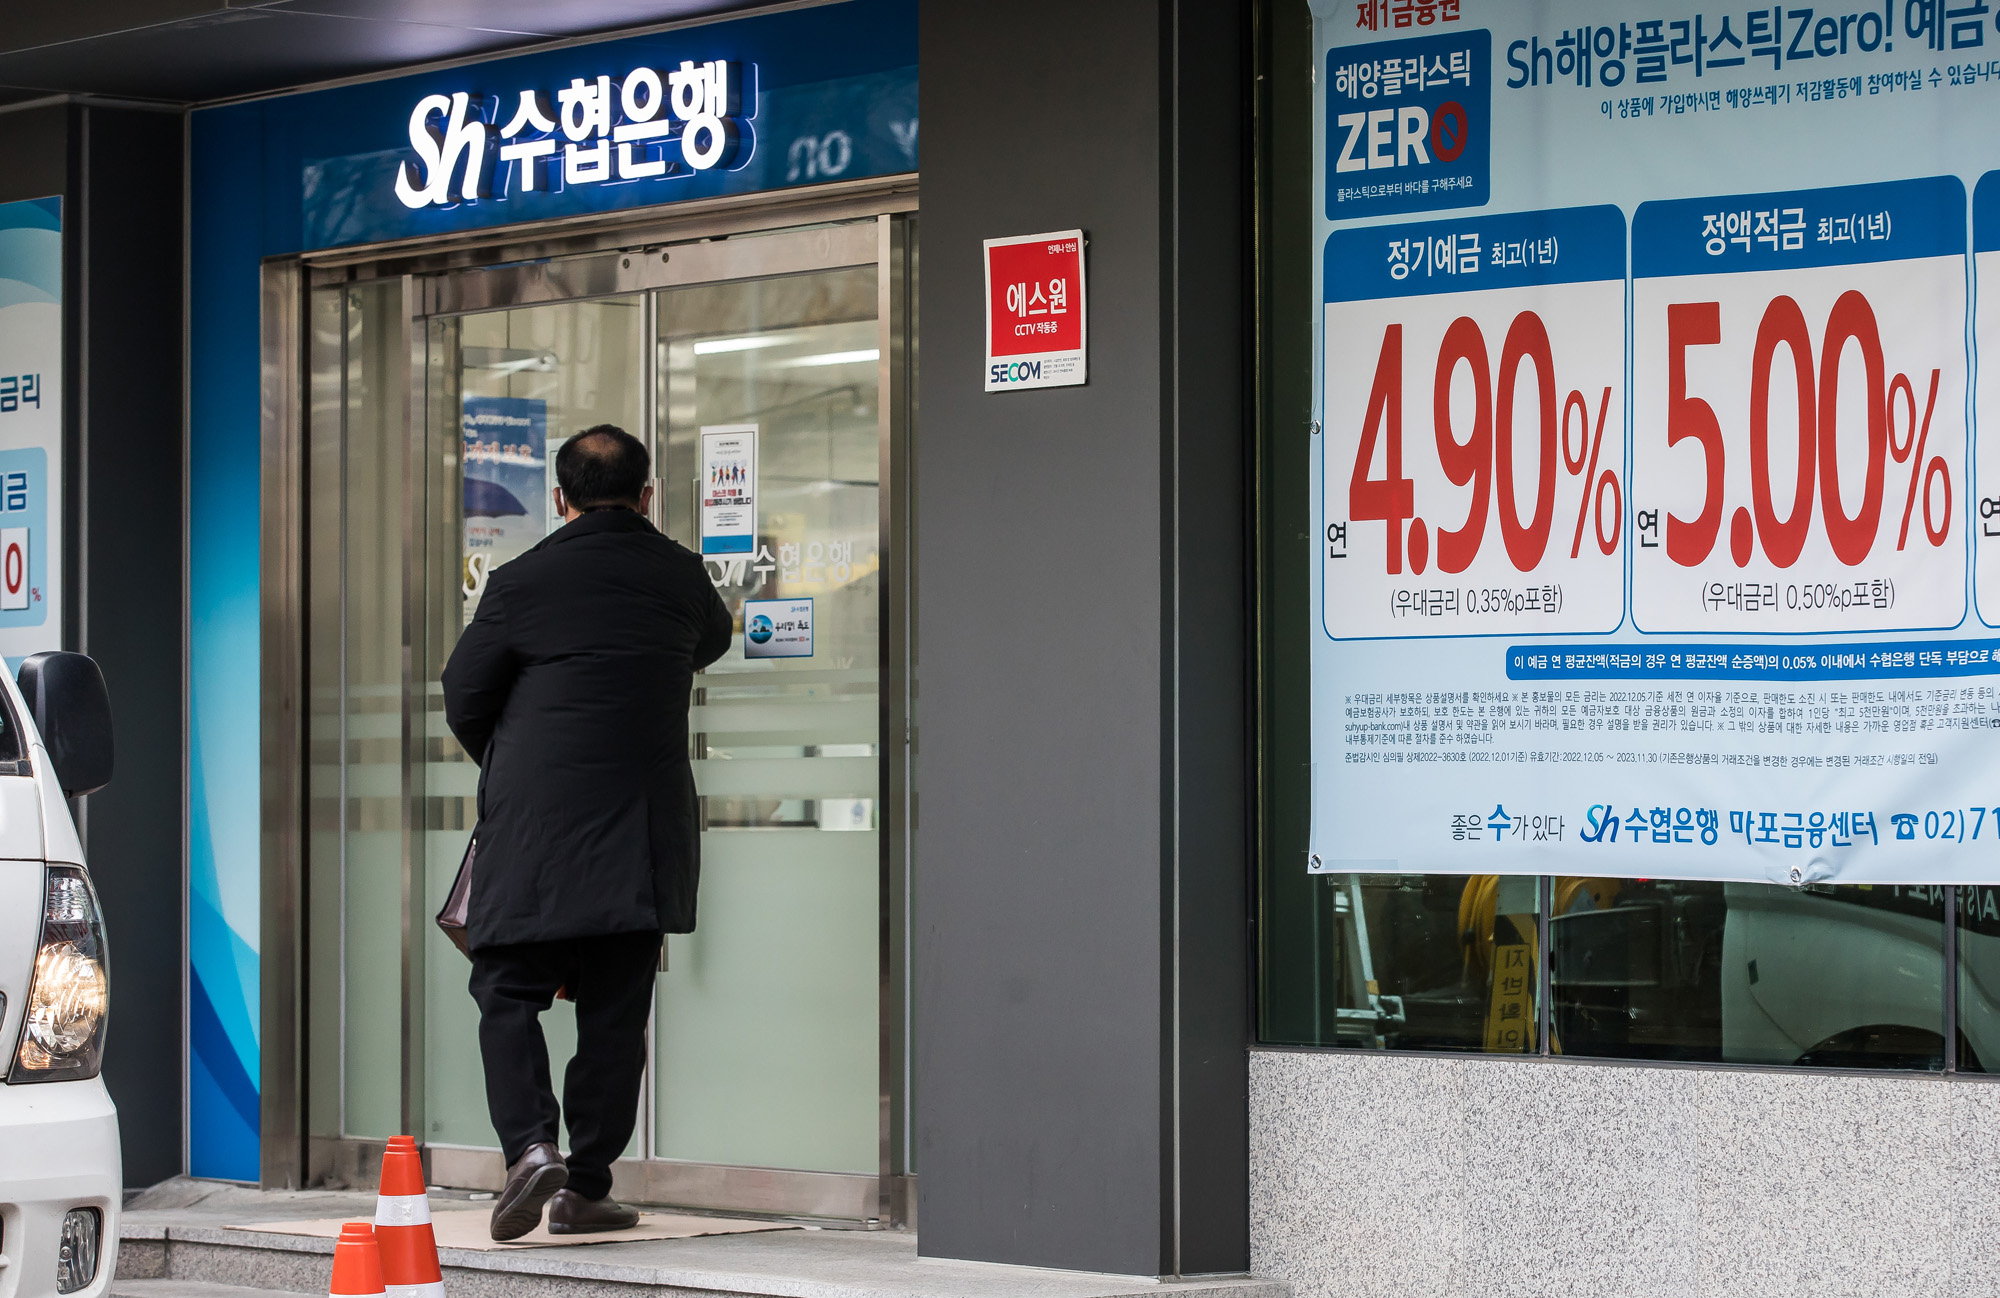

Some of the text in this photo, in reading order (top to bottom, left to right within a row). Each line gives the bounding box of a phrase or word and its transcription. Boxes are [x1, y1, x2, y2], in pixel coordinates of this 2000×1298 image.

[1506, 0, 2000, 89] Sh해양플라스틱Zero! 예금
[1336, 50, 1470, 99] 해양플라스틱
[1601, 100, 1612, 119] 이
[1618, 97, 1653, 119] 상품에
[1660, 91, 1720, 114] 가입하시면
[1726, 83, 1790, 109] 해양쓰레기
[1796, 76, 1862, 102] 저감활동에
[1868, 69, 1921, 95] 참여하실
[1928, 67, 1942, 88] 수
[395, 92, 486, 210] Sh
[500, 60, 728, 193] 수협은행
[1336, 101, 1468, 173] ZERO
[1337, 176, 1473, 201] 플라스틱으로부터 바다를 구해주세요
[1065, 242, 1076, 252] 안심
[1702, 208, 1891, 256] 정액적금 최고(1년)
[1388, 233, 1558, 280] 정기예금 최고(1년)
[1007, 278, 1067, 318] 에스원
[1015, 321, 1057, 336] CCTV 작동중
[991, 361, 1040, 383] SECOM
[1327, 310, 1621, 576] 연 4.90%
[1638, 290, 1952, 568] 연 5.00%
[753, 541, 852, 584] 수협은행
[1390, 584, 1563, 618] (우대금리 0.35%p포함)
[1702, 578, 1895, 611] (우대금리 0.50%p포함)
[1514, 650, 1988, 670] 이 예금 연 평균잔액(적금의 경우 연 평균잔액 순증액)의 0.05% 이내에서 수협은행 단독 부담으로
[1346, 707, 1396, 718] 예금보험공사가
[1400, 706, 1430, 717] 보호하되,
[1434, 706, 1448, 716] 보호
[1452, 706, 1474, 717] 한도는
[1478, 706, 1485, 716] 본
[1489, 706, 1511, 717] 은행에
[1515, 705, 1530, 716] 있는
[1534, 705, 1557, 716] 귀하의
[1561, 705, 1576, 716] 모든
[1582, 705, 1620, 716] 예금자보호
[1625, 705, 1640, 716] 대상
[1645, 705, 1686, 718] 금융상품의
[1691, 706, 1716, 718] 원금과
[1721, 706, 1744, 718] 소정의
[1750, 707, 1774, 719] 이자를
[1779, 707, 1803, 719] 합하여
[1809, 707, 1829, 719] 1인당
[1953, 702, 1986, 714] 초과하는
[1354, 694, 1382, 704] 우대금리
[1386, 693, 1422, 704] 세부항목은
[1426, 692, 1468, 704] 상품설명서를
[1472, 692, 1509, 702] 확인하세요
[1521, 692, 1528, 702] 본
[1532, 692, 1561, 702] 홍보물의
[1565, 691, 1580, 702] 모든
[1584, 691, 1606, 702] 금리는
[1667, 691, 1682, 702] 세전
[1687, 691, 1694, 703] 연
[1698, 692, 1722, 703] 이자율
[1726, 692, 1759, 704] 기준으로,
[1763, 693, 1795, 704] 판매한도
[1799, 693, 1815, 704] 소진
[1819, 693, 1827, 703] 시
[1831, 693, 1847, 703] 또는
[1852, 692, 1884, 703] 판매한도
[1889, 691, 1922, 703] 내에서도
[1926, 689, 1957, 701] 기준금리
[1978, 687, 1994, 700] 등의
[1346, 733, 1494, 745] 내부통제기준에 따른 절차를 준수 하였습니다.
[1413, 720, 1427, 731] 상품
[1432, 720, 1453, 731] 설명서
[1457, 720, 1463, 731] 및
[1466, 719, 1488, 731] 약관을
[1492, 719, 1506, 731] 읽어
[1509, 719, 1531, 730] 보시기
[1535, 719, 1559, 730] 바라며,
[1563, 719, 1585, 731] 필요한
[1589, 719, 1603, 730] 경우
[1607, 719, 1629, 731] 설명을
[1633, 719, 1648, 731] 받을
[1652, 719, 1677, 731] 권리가
[1681, 720, 1714, 732] 있습니다.
[1728, 721, 1736, 731] 그
[1739, 721, 1754, 732] 밖의
[1758, 722, 1783, 733] 상품에
[1787, 722, 1802, 734] 대한
[1806, 721, 1831, 734] 자세한
[1836, 720, 1859, 733] 내용은
[1864, 720, 1889, 732] 가까운
[1894, 719, 1916, 732] 영업점
[1345, 752, 1380, 763] 준법감시인
[1383, 752, 1404, 763] 심의필
[1617, 752, 1657, 763] 2023.11.30
[1660, 752, 1718, 764] (기존은행상품의
[1722, 754, 1760, 766] 거래조건을
[1763, 756, 1787, 767] 변경한
[1791, 756, 1823, 768] 경우에는
[1826, 755, 1850, 767] 변경된
[1854, 755, 1884, 766] 거래조건
[1886, 754, 1915, 766] 시행일의
[1918, 753, 1938, 765] 전일)
[1451, 814, 1483, 841] 좋은
[1488, 804, 1529, 842] 수가
[1532, 815, 1565, 842] 있다
[1624, 807, 1718, 846] 수협은행
[1730, 810, 1878, 848] 마포금융센터
